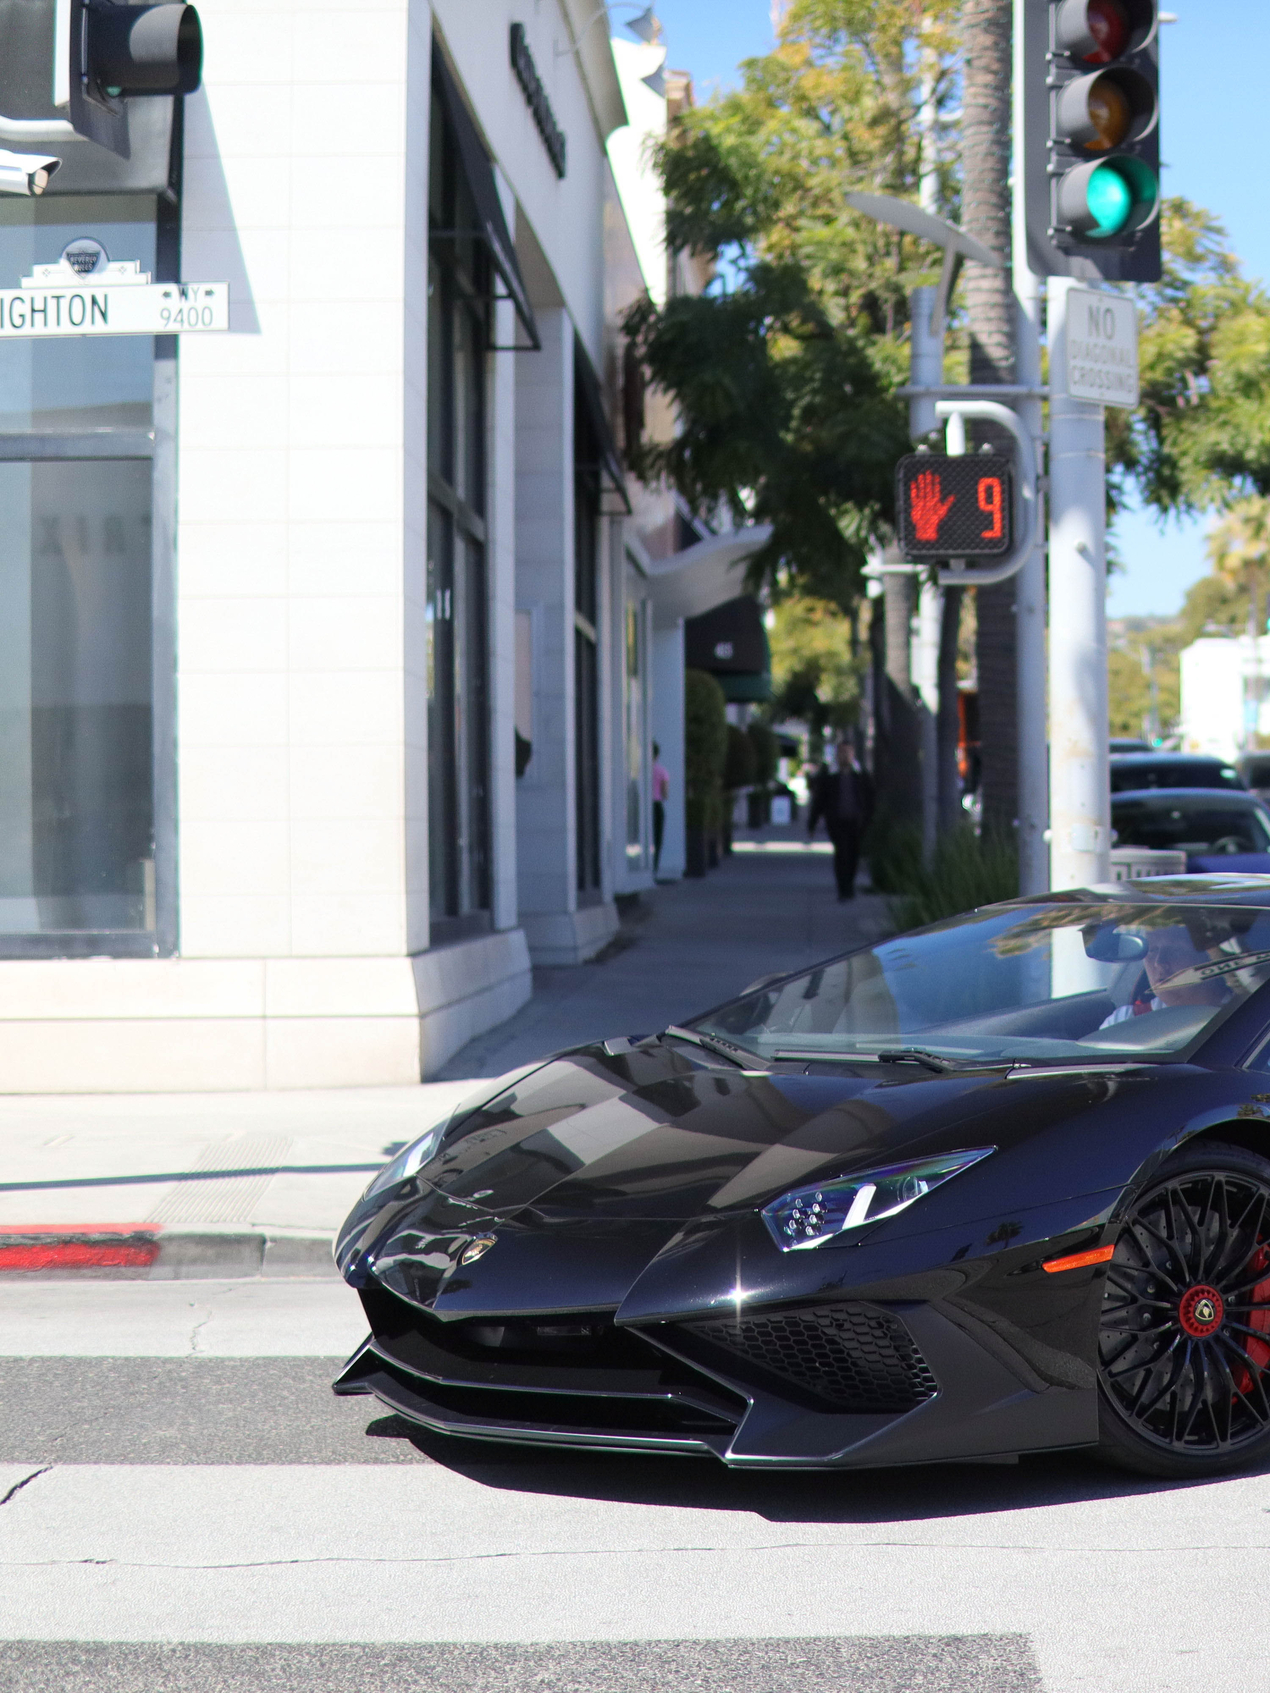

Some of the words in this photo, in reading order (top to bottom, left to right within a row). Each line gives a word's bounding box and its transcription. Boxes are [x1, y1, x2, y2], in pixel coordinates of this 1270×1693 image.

[177, 286, 200, 303] WY
[160, 305, 214, 328] 9400
[1088, 304, 1115, 340] NO
[977, 477, 1002, 538] 9
